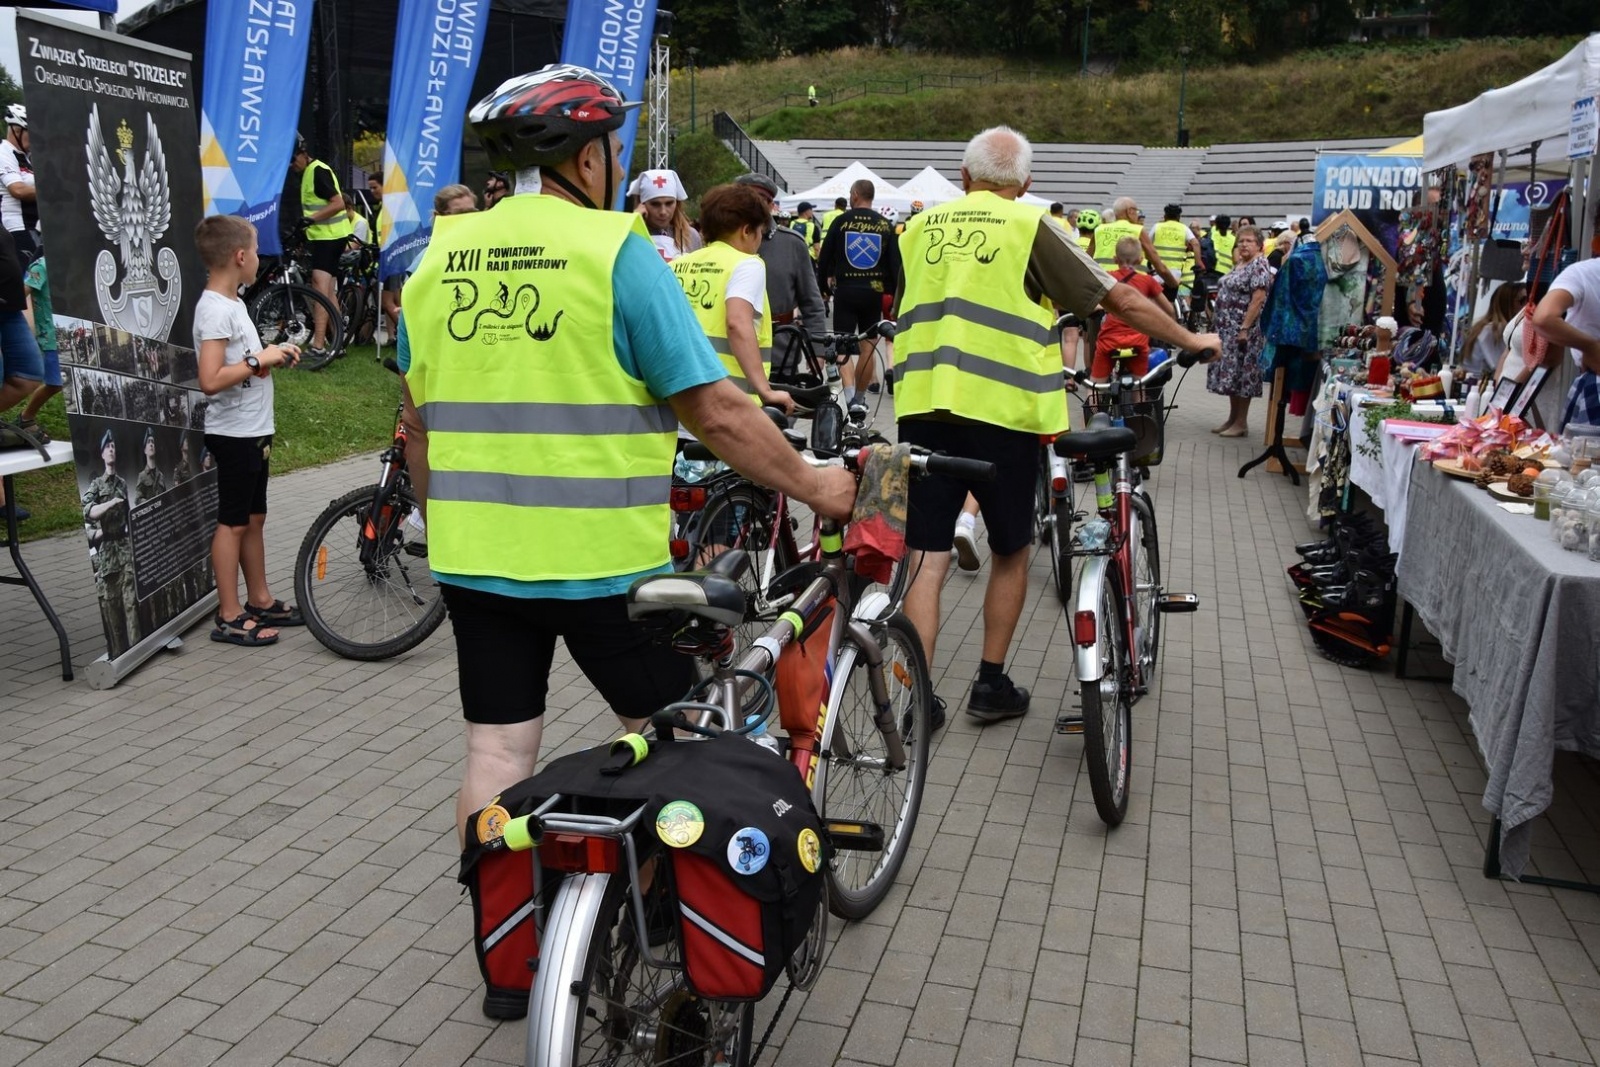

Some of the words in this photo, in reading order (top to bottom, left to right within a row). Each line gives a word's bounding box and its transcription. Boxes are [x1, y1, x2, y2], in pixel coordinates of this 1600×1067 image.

[1323, 189, 1373, 210] RAJD
[924, 212, 949, 227] XXII
[488, 246, 546, 259] POWIATOWY
[445, 248, 481, 273] XXII
[486, 259, 510, 272] RAJD
[511, 259, 568, 271] ROWEROWY
